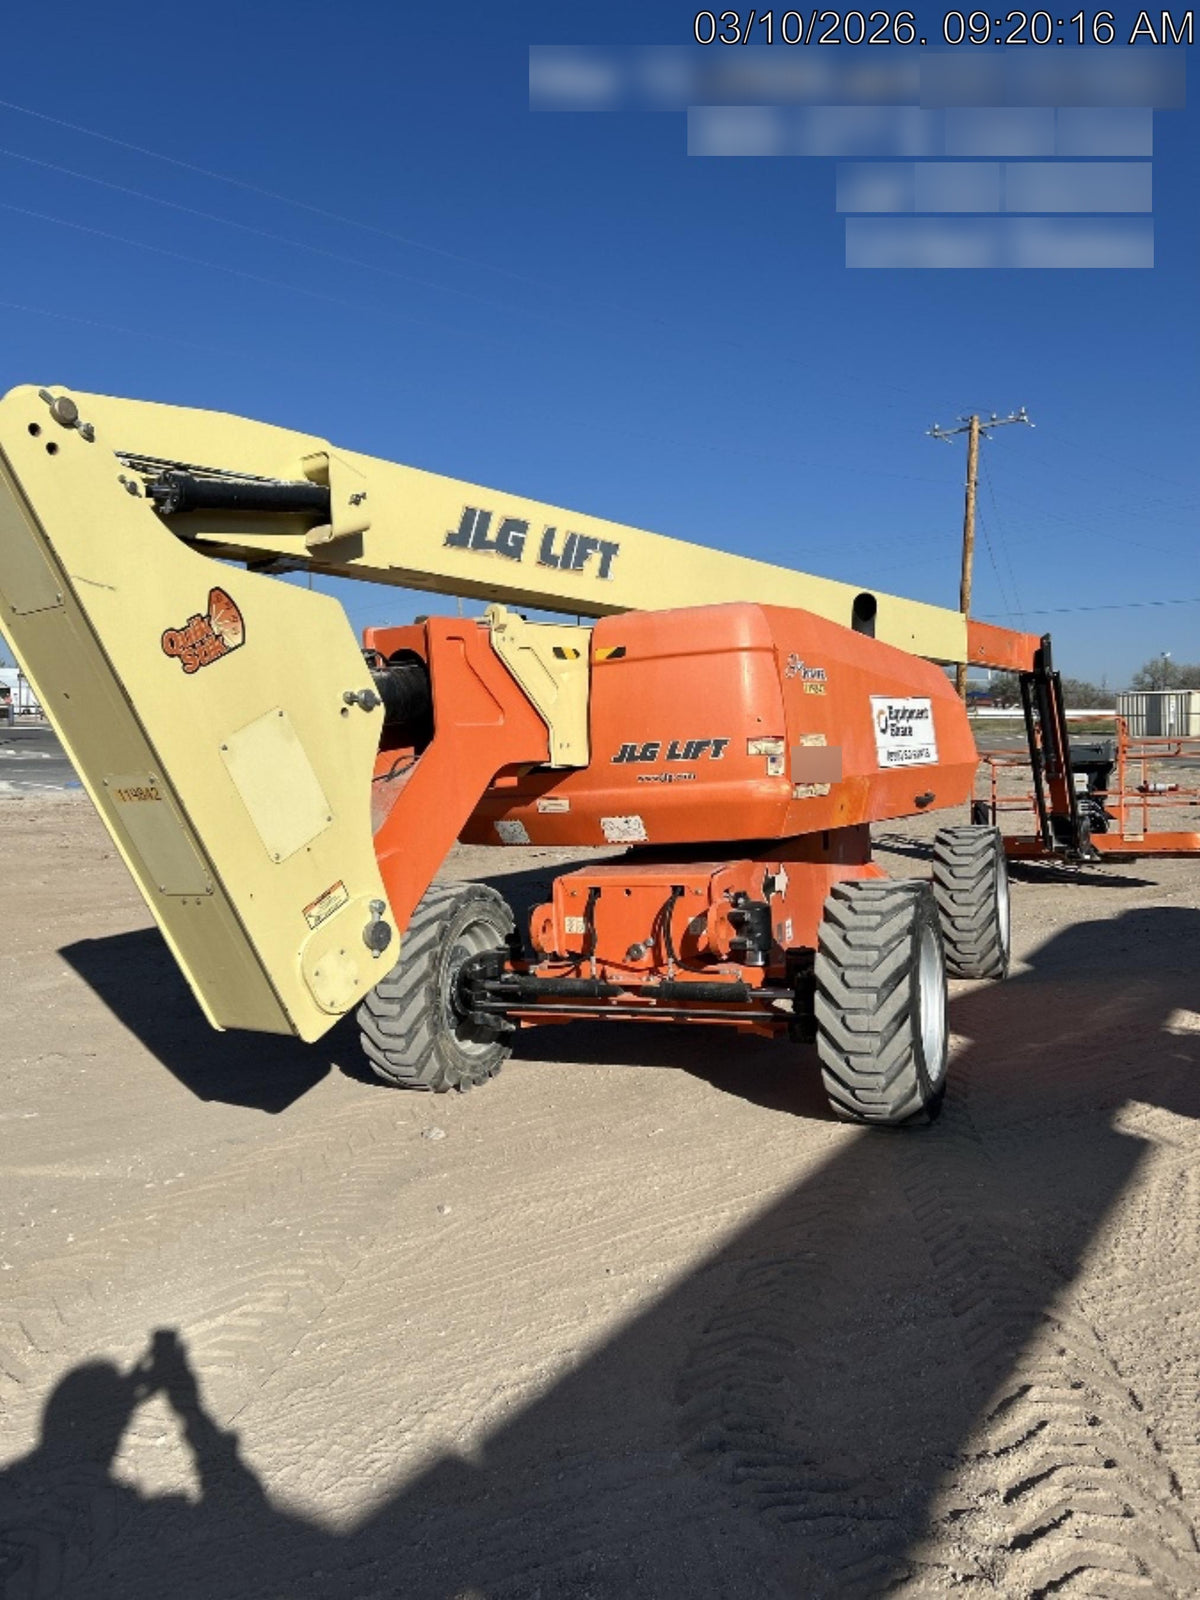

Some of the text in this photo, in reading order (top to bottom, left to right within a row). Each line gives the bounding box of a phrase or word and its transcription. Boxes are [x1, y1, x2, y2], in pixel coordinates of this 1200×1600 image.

[443, 505, 621, 582] JLG LIFT
[610, 742, 661, 765] JLG
[664, 738, 730, 762] LIFT
